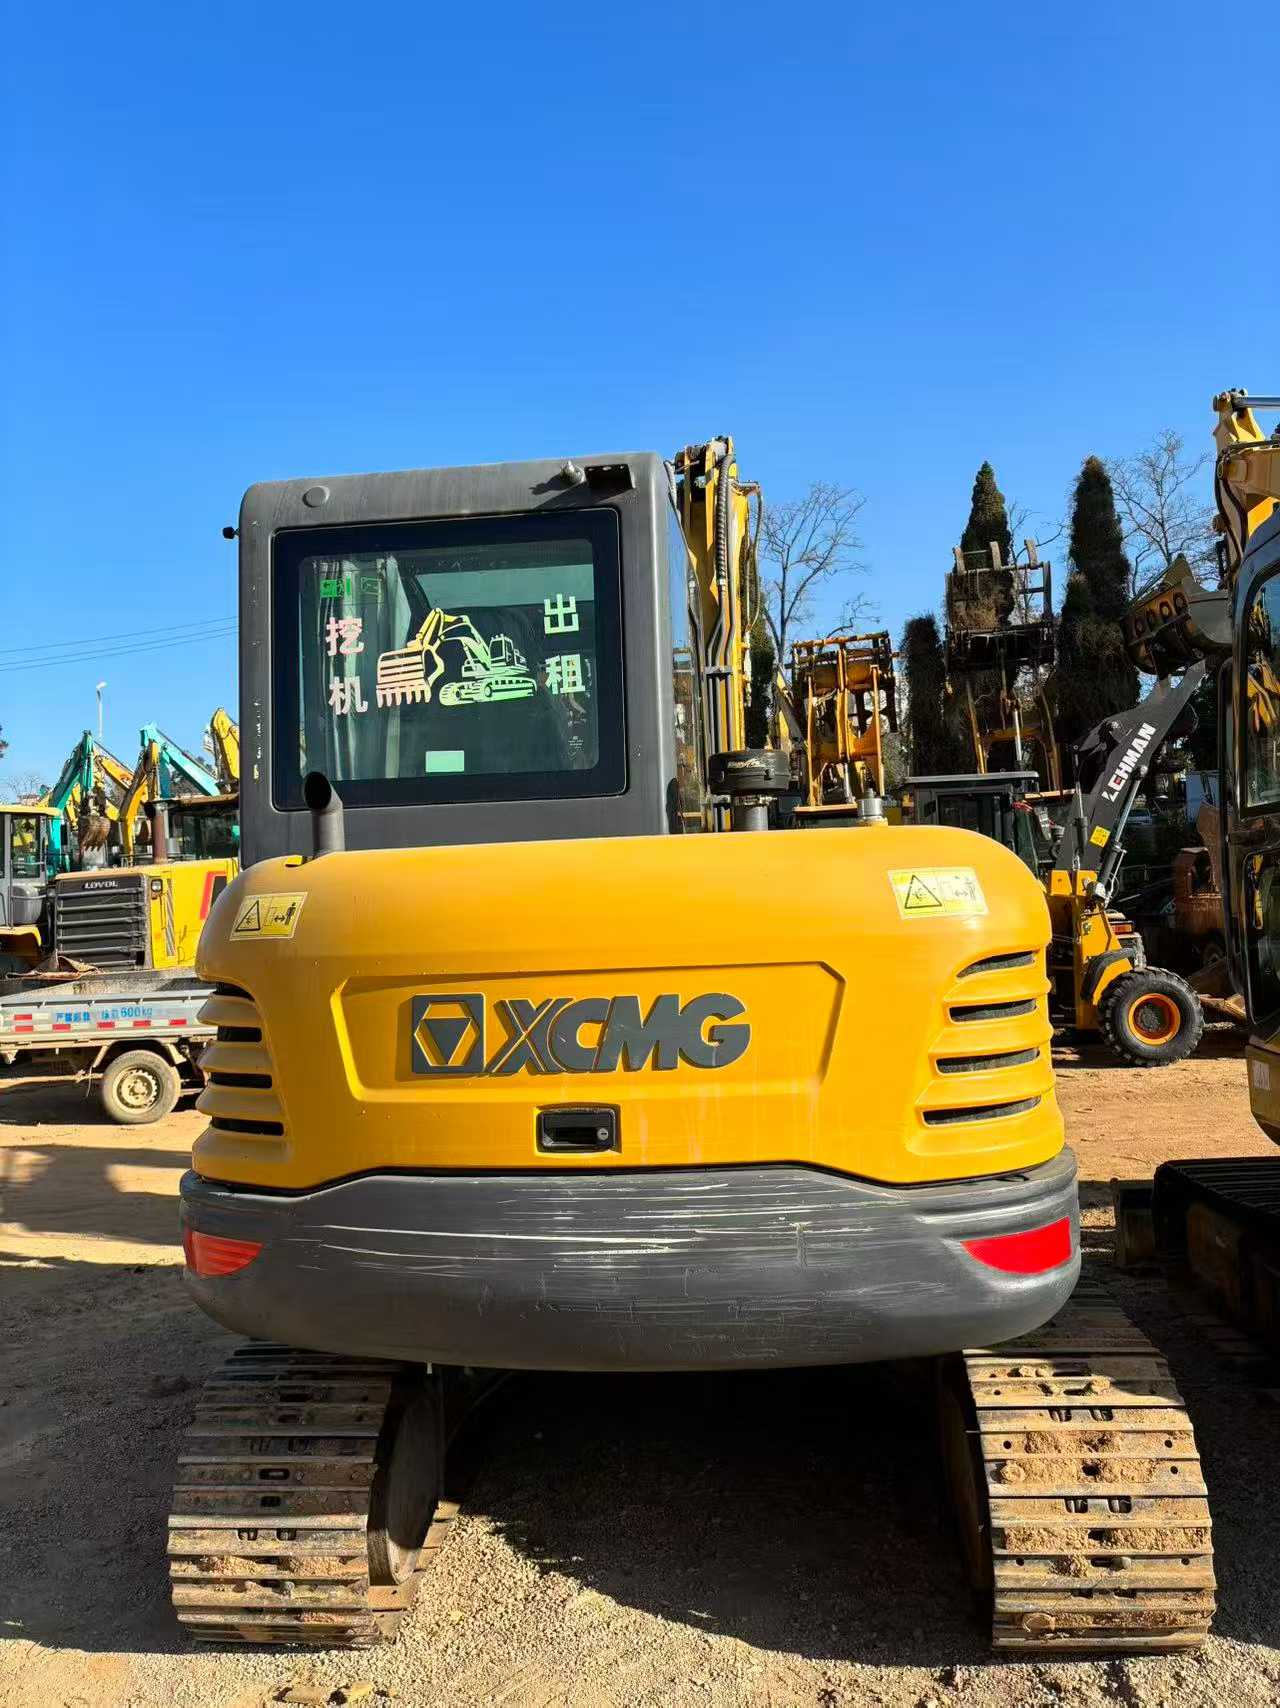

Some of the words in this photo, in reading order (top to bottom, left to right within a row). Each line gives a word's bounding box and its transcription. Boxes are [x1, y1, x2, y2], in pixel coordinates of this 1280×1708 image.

[325, 616, 369, 716] 挖机
[543, 593, 586, 695] 出租
[1101, 722, 1157, 803] LEHMAN
[84, 880, 119, 889] LOVOL
[485, 992, 752, 1077] XCMG
